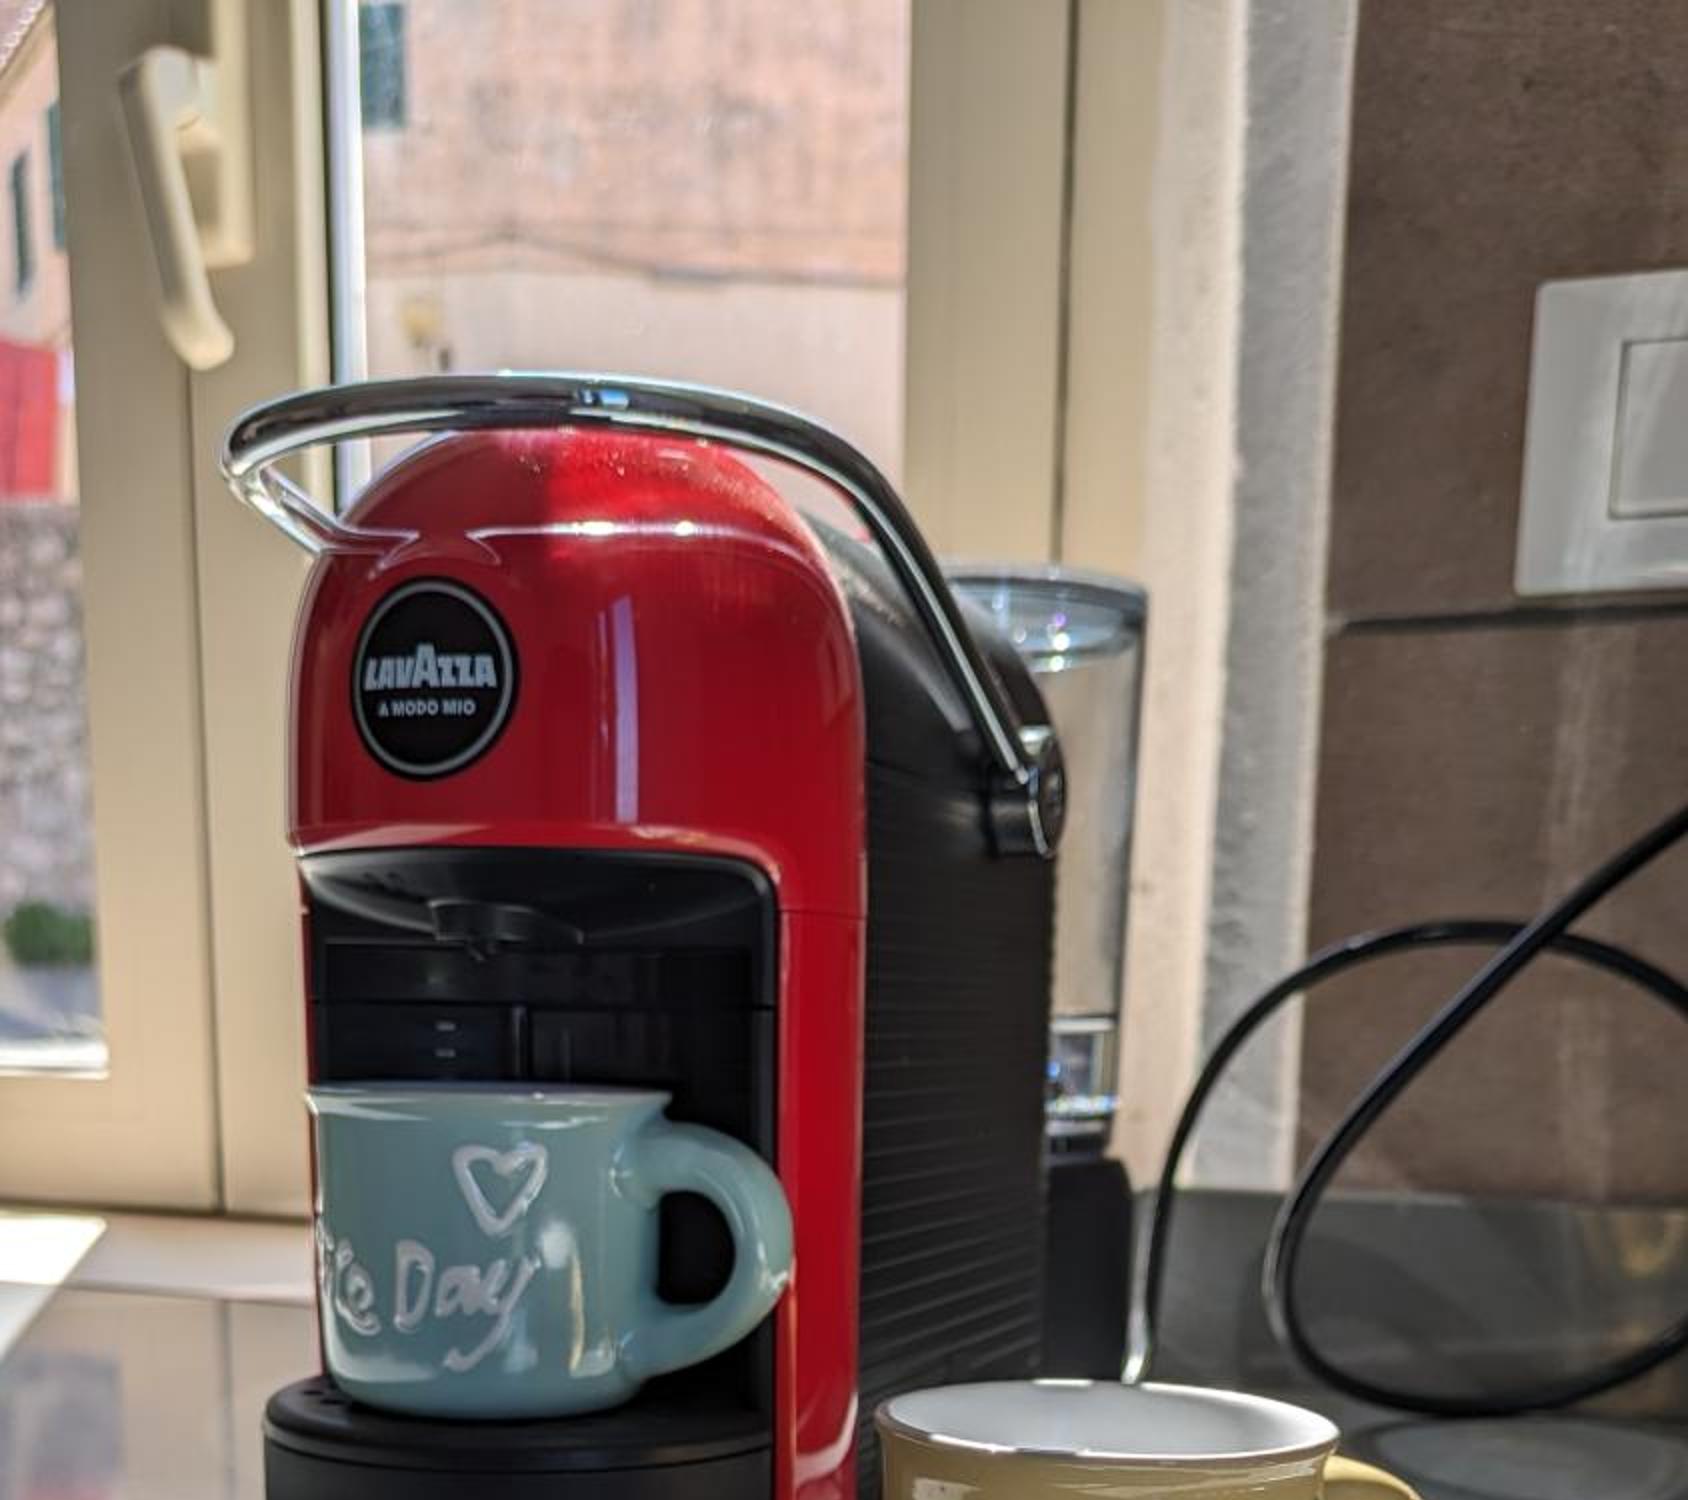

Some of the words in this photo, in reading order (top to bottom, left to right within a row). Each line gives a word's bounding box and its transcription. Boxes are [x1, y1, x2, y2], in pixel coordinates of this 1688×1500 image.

[364, 643, 497, 691] LAVAZZA
[378, 702, 389, 717] A
[392, 700, 438, 717] MODO
[442, 699, 476, 716] MIO
[394, 1239, 541, 1372] Day
